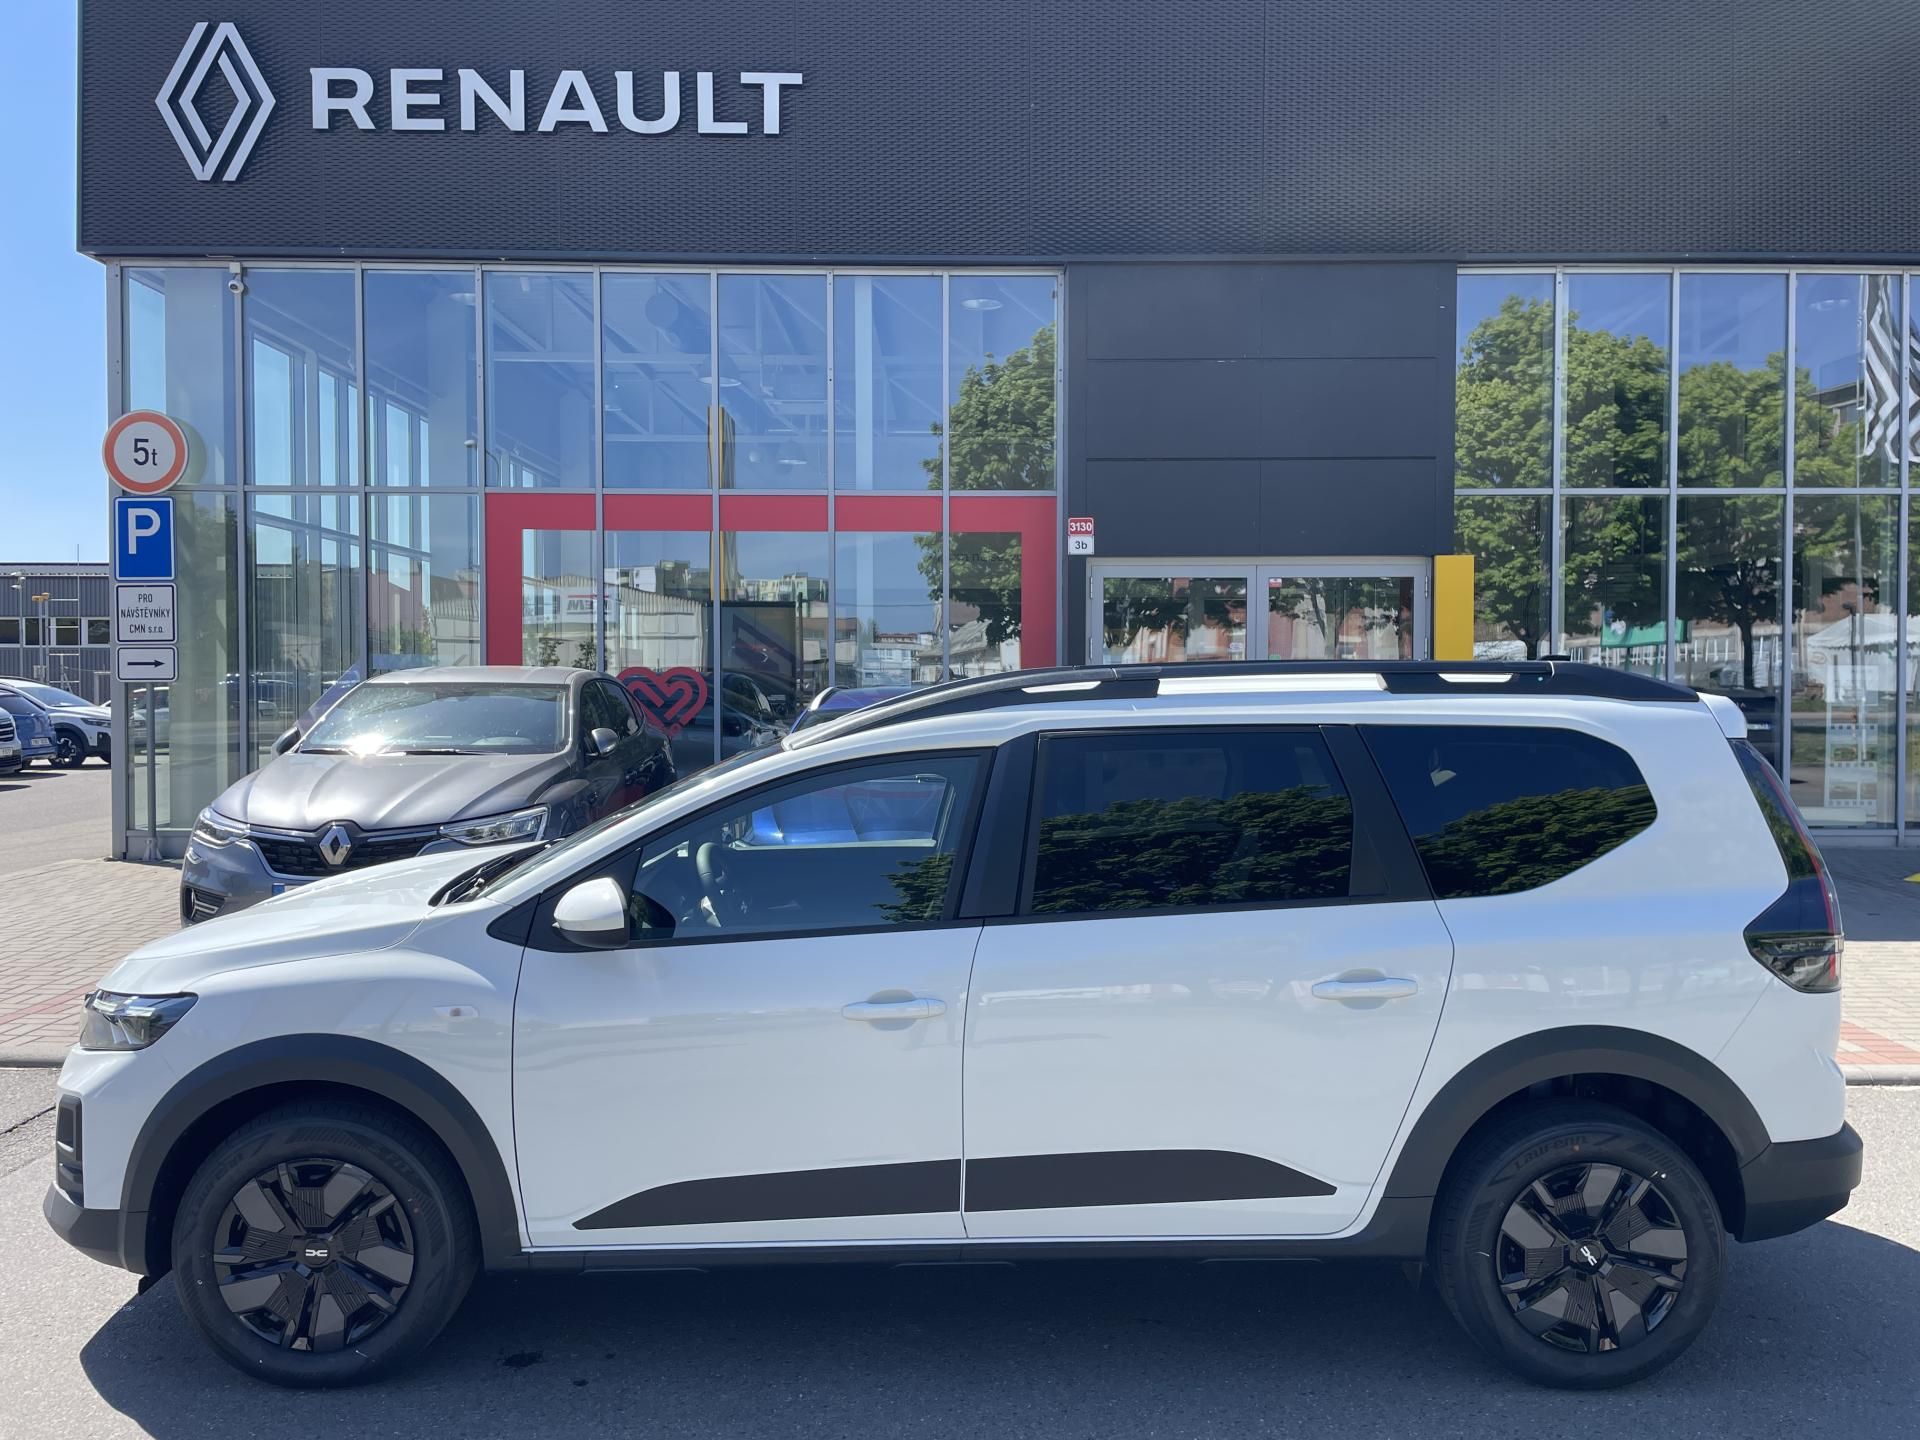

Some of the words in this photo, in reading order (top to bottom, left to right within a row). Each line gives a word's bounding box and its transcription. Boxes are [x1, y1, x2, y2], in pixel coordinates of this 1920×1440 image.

[309, 67, 804, 136] RENAULT
[133, 438, 158, 467] 5t
[127, 508, 161, 555] P
[1070, 522, 1092, 532] 3130
[1074, 540, 1088, 550] 3b
[138, 593, 153, 603] PRO
[120, 606, 171, 618] NÁVŠTĚVNÍKY
[129, 623, 146, 633] CMN
